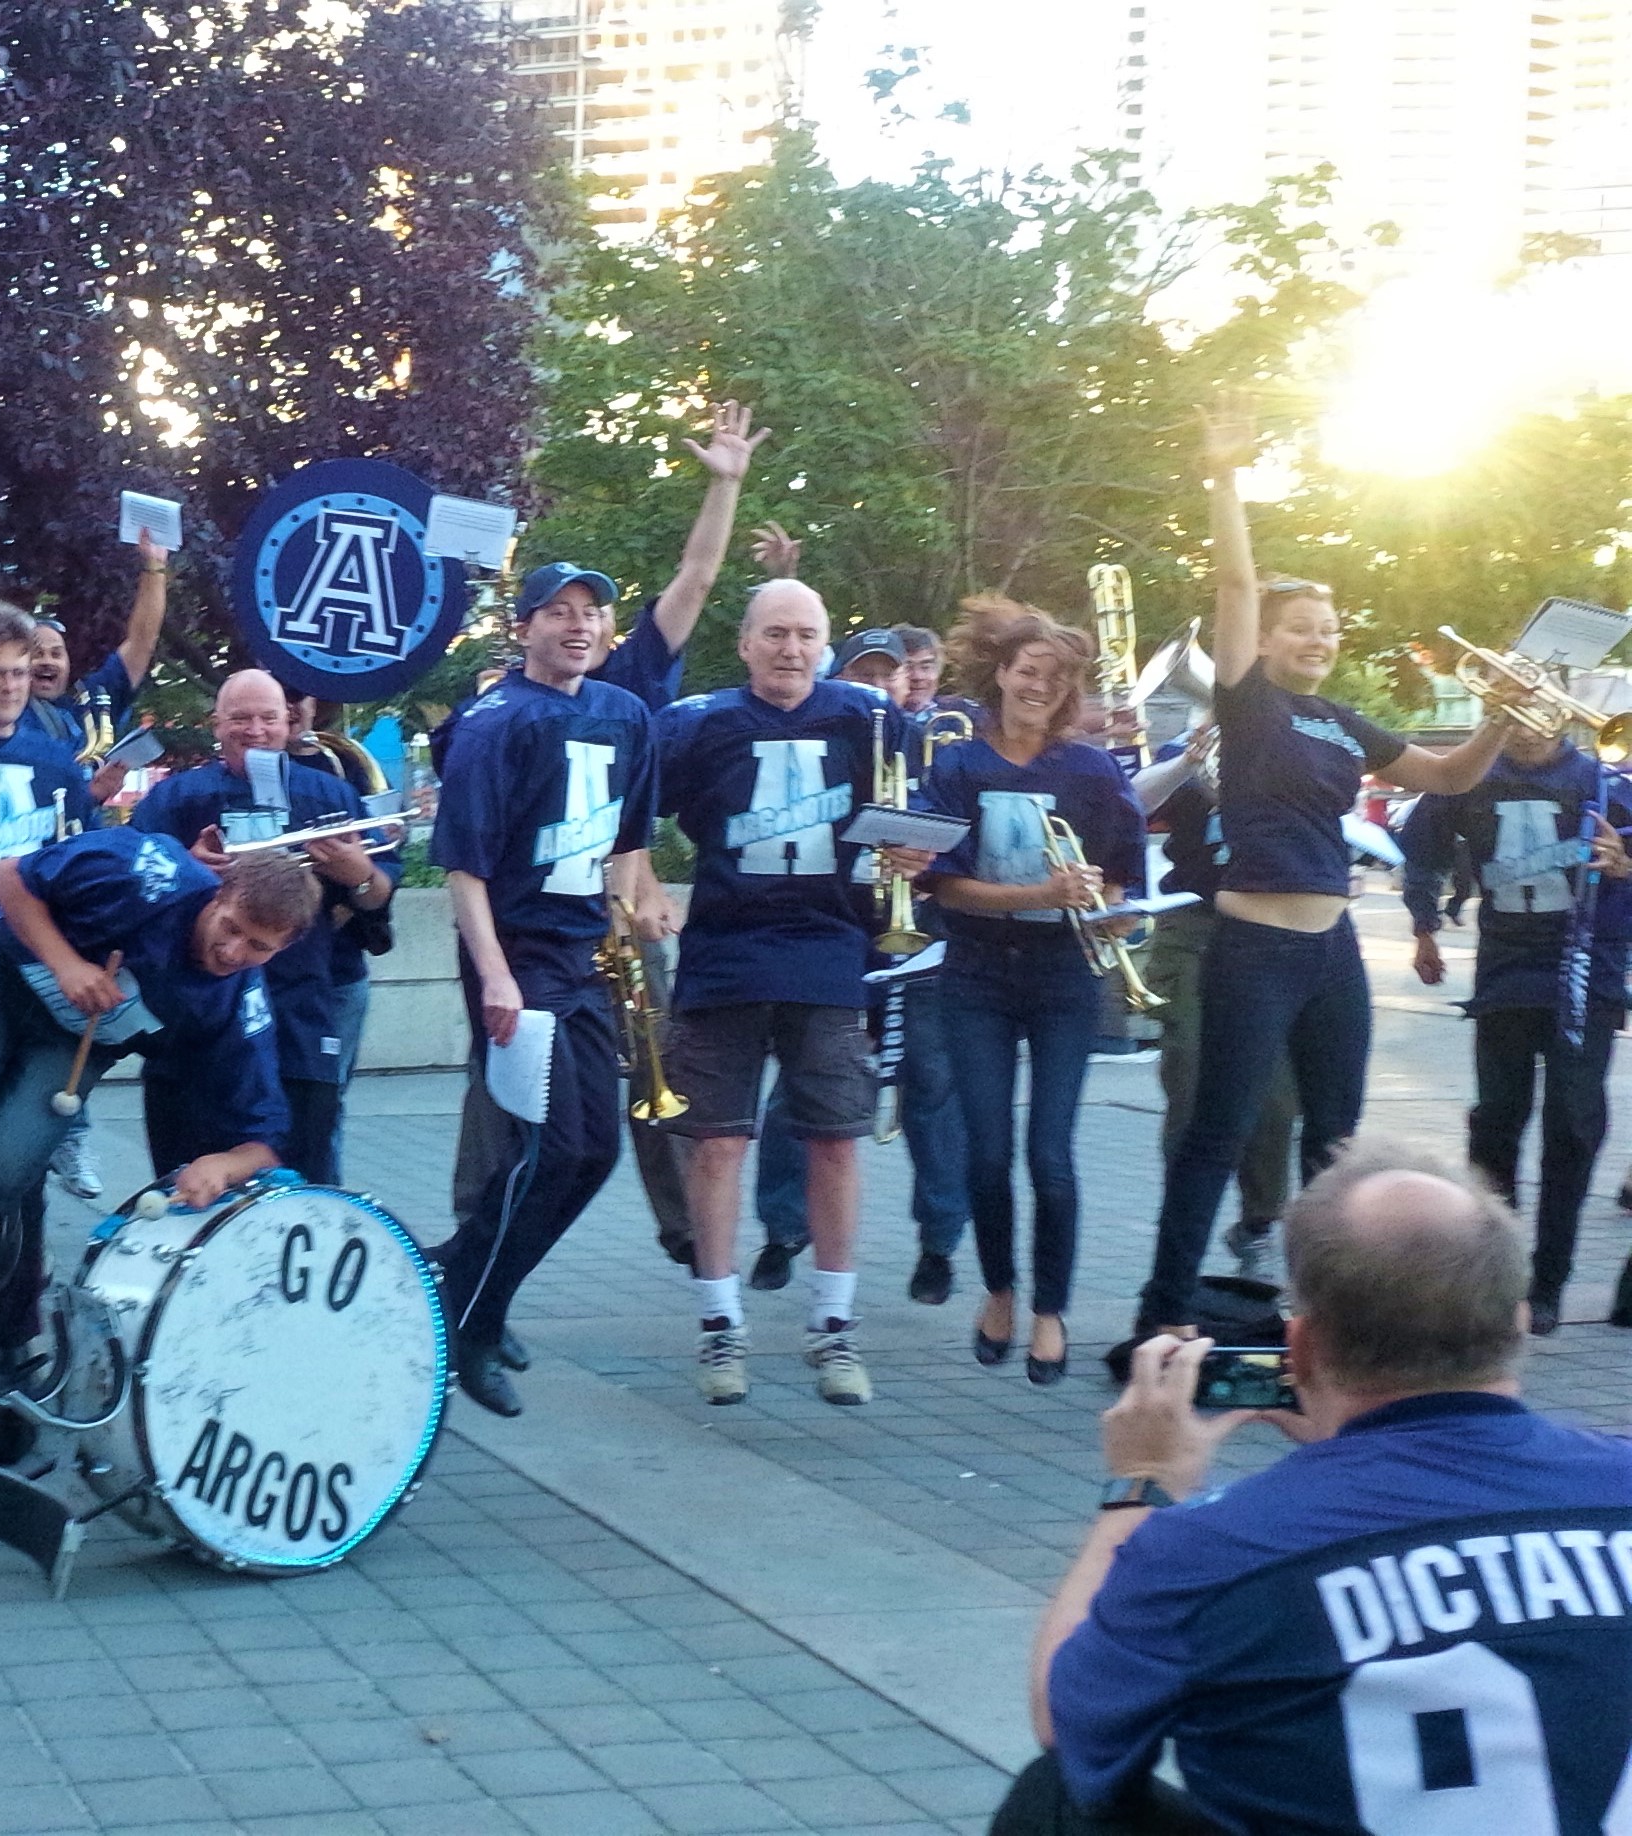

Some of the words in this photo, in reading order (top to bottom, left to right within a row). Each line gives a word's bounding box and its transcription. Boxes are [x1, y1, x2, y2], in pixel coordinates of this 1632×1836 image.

[270, 507, 411, 661] A
[281, 1224, 367, 1312] GO
[173, 1418, 352, 1542] ARGOS
